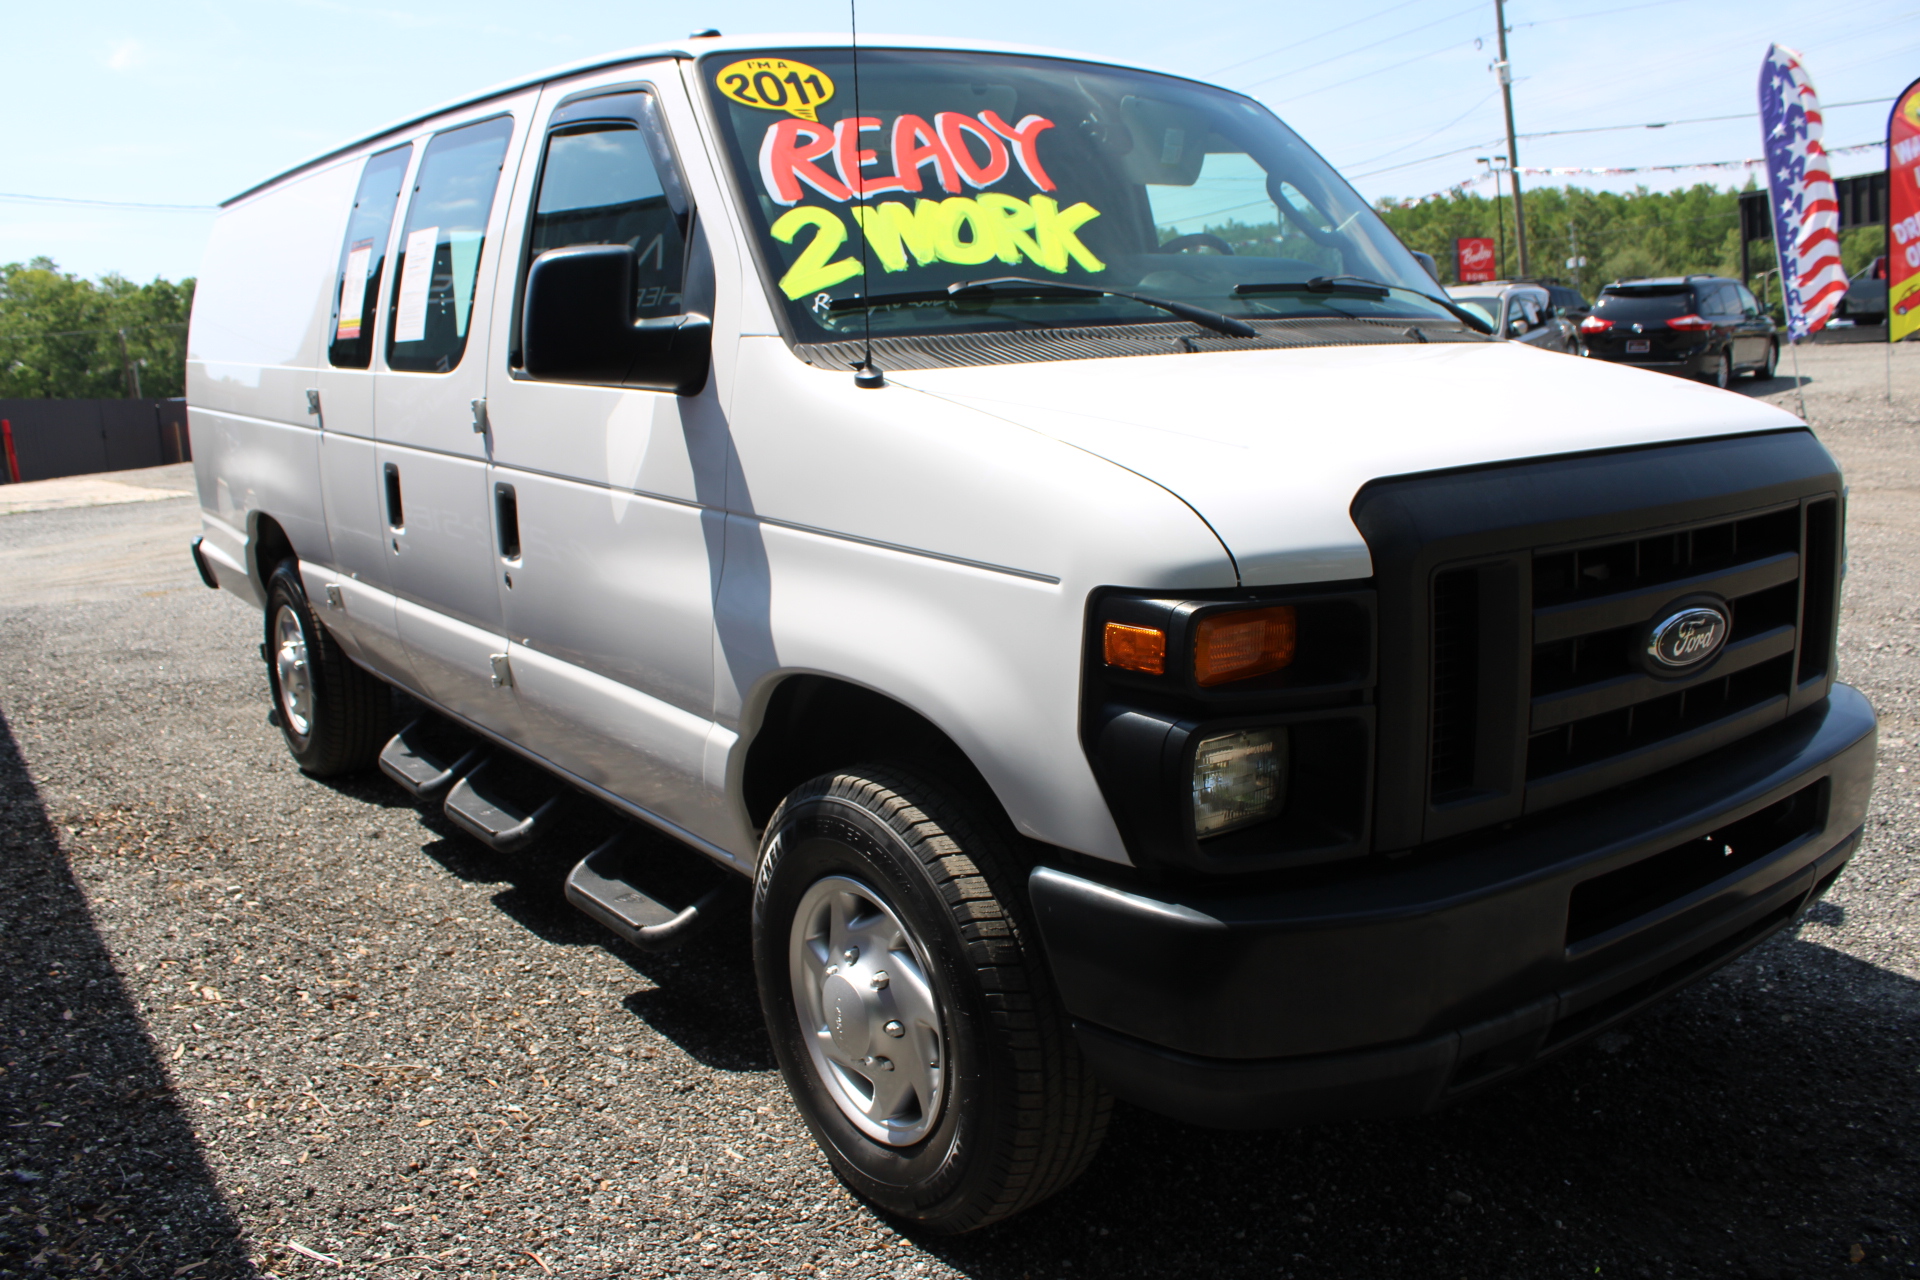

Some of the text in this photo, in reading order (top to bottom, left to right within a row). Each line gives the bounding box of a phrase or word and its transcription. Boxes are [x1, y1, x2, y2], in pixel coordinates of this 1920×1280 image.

[746, 61, 788, 69] I'M A
[724, 70, 826, 107] 2011
[759, 110, 1056, 207] READY
[770, 193, 1106, 300] 2 WORK
[1673, 618, 1717, 657] Ford
